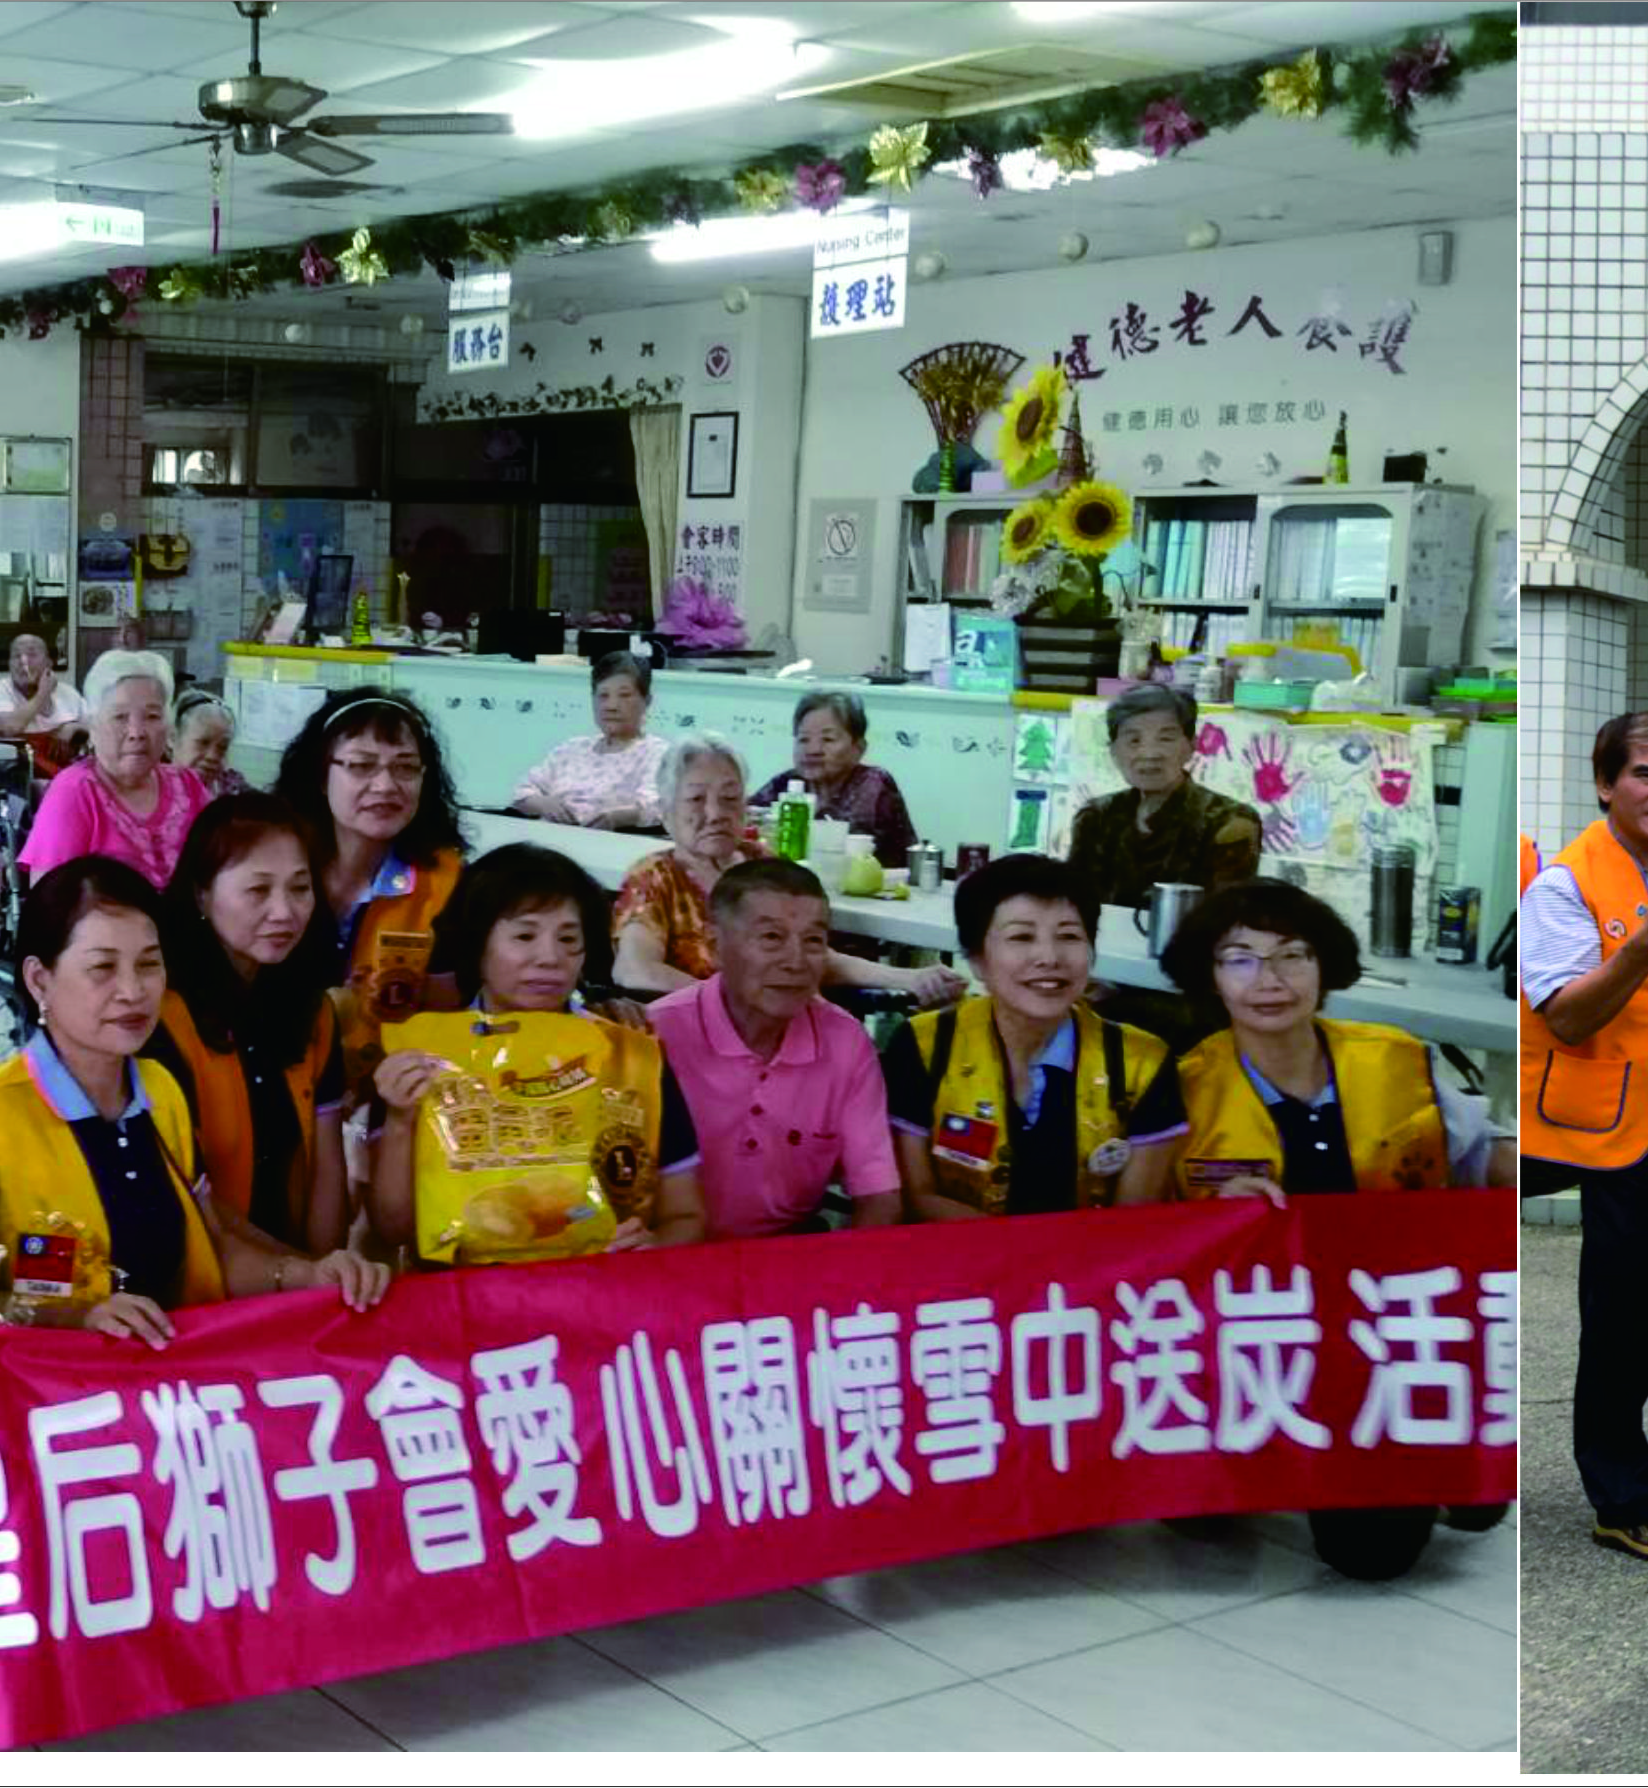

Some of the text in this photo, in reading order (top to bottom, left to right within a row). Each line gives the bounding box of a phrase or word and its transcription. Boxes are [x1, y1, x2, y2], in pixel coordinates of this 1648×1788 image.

[819, 274, 895, 325] 護理站
[452, 322, 503, 363] 服務台
